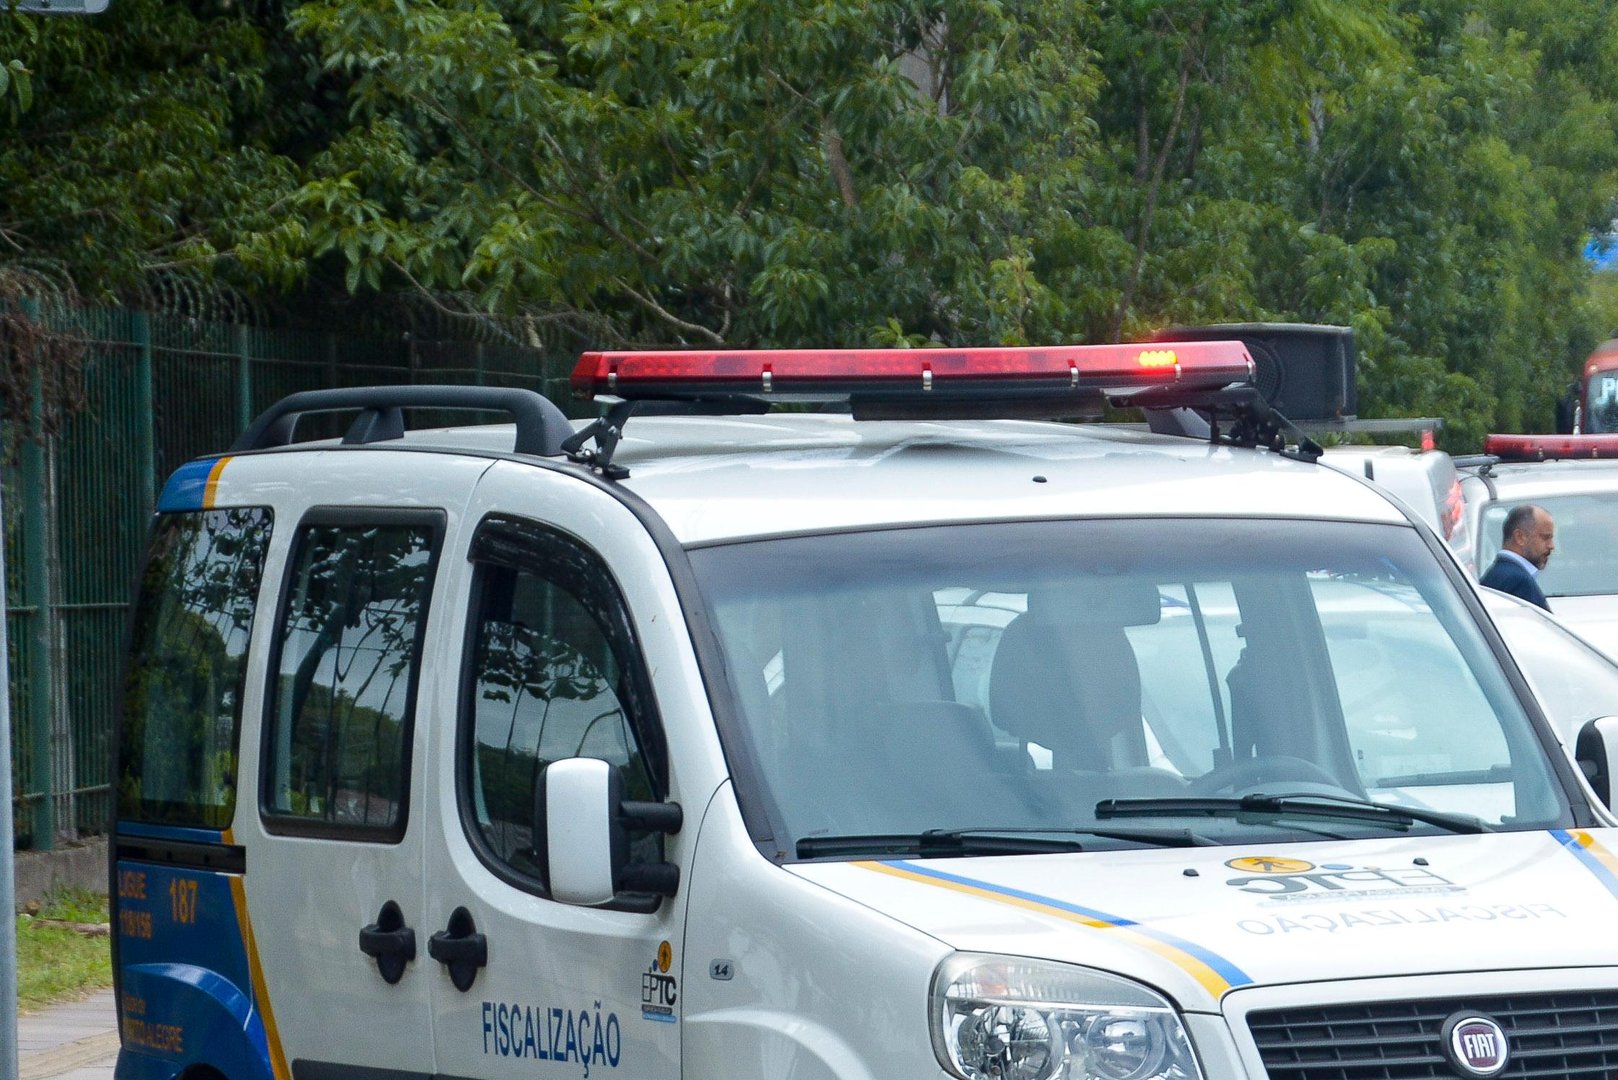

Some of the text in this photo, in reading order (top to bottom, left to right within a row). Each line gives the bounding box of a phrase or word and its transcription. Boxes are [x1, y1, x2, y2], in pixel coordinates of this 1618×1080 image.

[169, 878, 198, 924] 187
[642, 972, 677, 1006] EPTC
[482, 1000, 620, 1079] FISCALIZAÇÃO
[1463, 1033, 1496, 1059] FIAT
